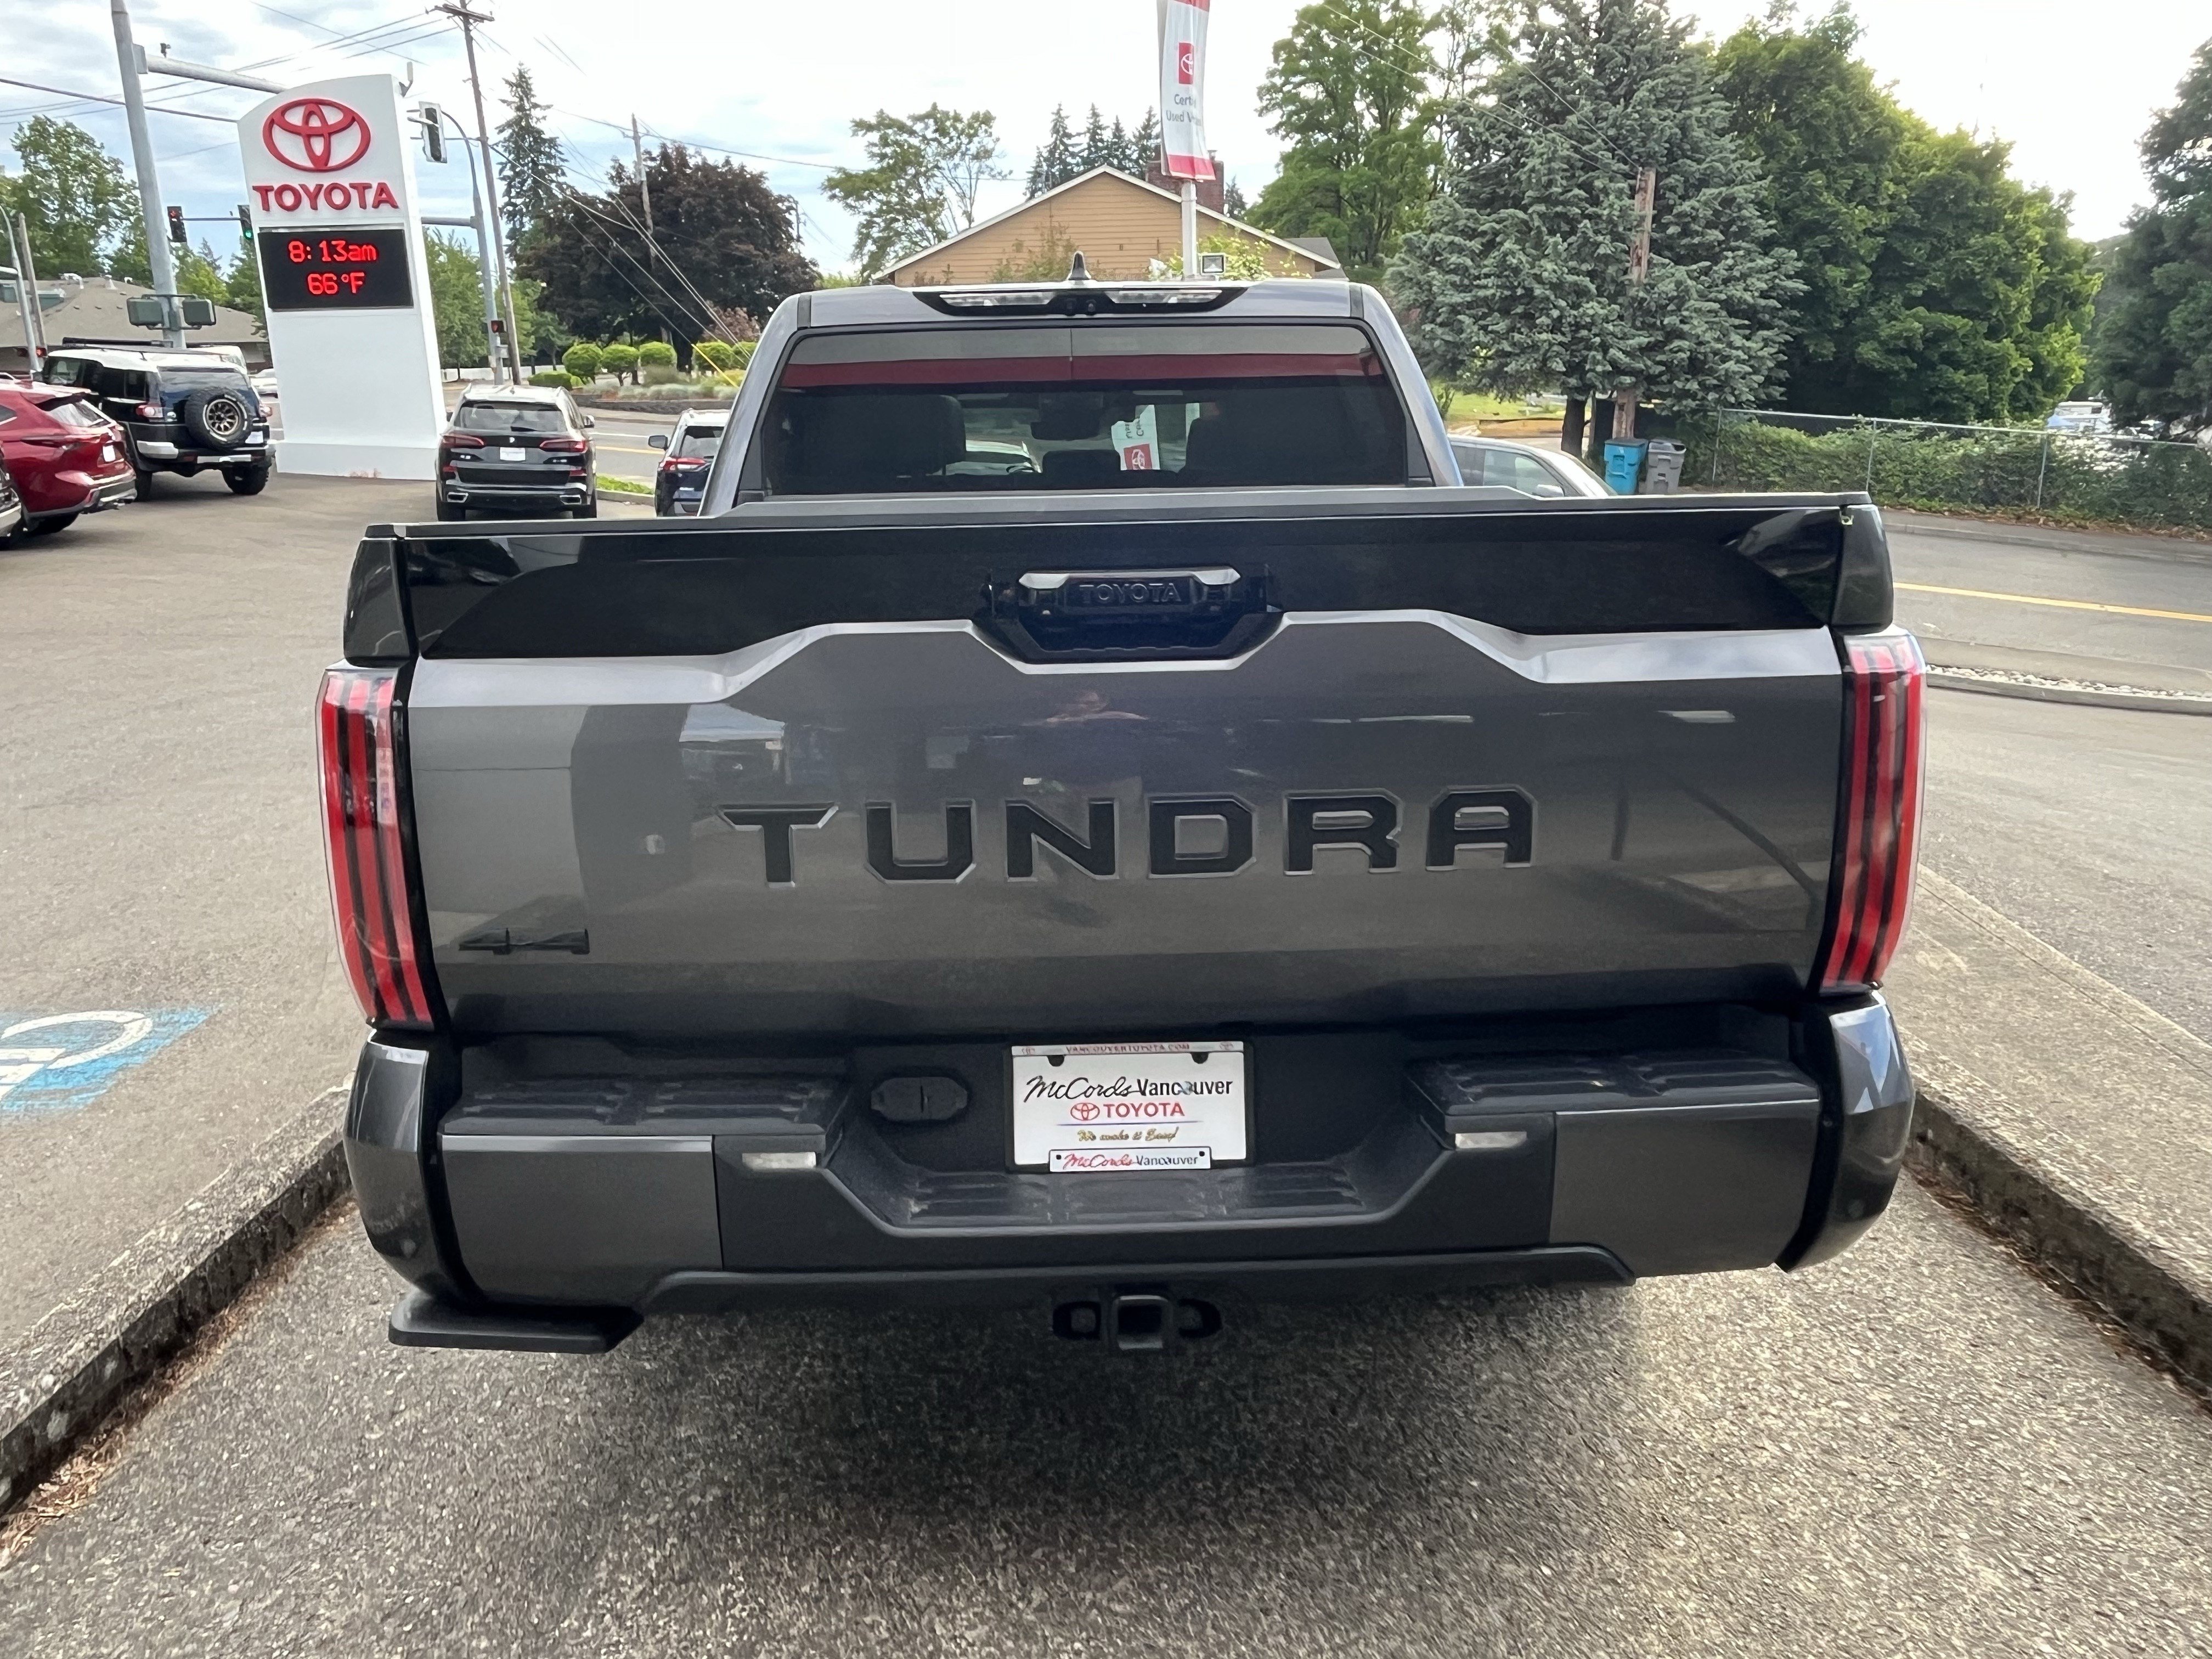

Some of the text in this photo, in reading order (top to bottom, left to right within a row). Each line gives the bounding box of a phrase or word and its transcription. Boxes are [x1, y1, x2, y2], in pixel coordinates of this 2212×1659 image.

[1166, 110, 1184, 122] Used
[252, 182, 399, 212] TOYOTA
[288, 240, 377, 263] 8:13am
[307, 272, 365, 295] 66°F
[1079, 583, 1181, 602] TOYOTA
[718, 783, 1537, 888] TUNDRA
[1137, 1078, 1233, 1096] Vancouver
[1103, 1102, 1185, 1118] TOYOTA
[1136, 1155, 1198, 1166] Vancouver
